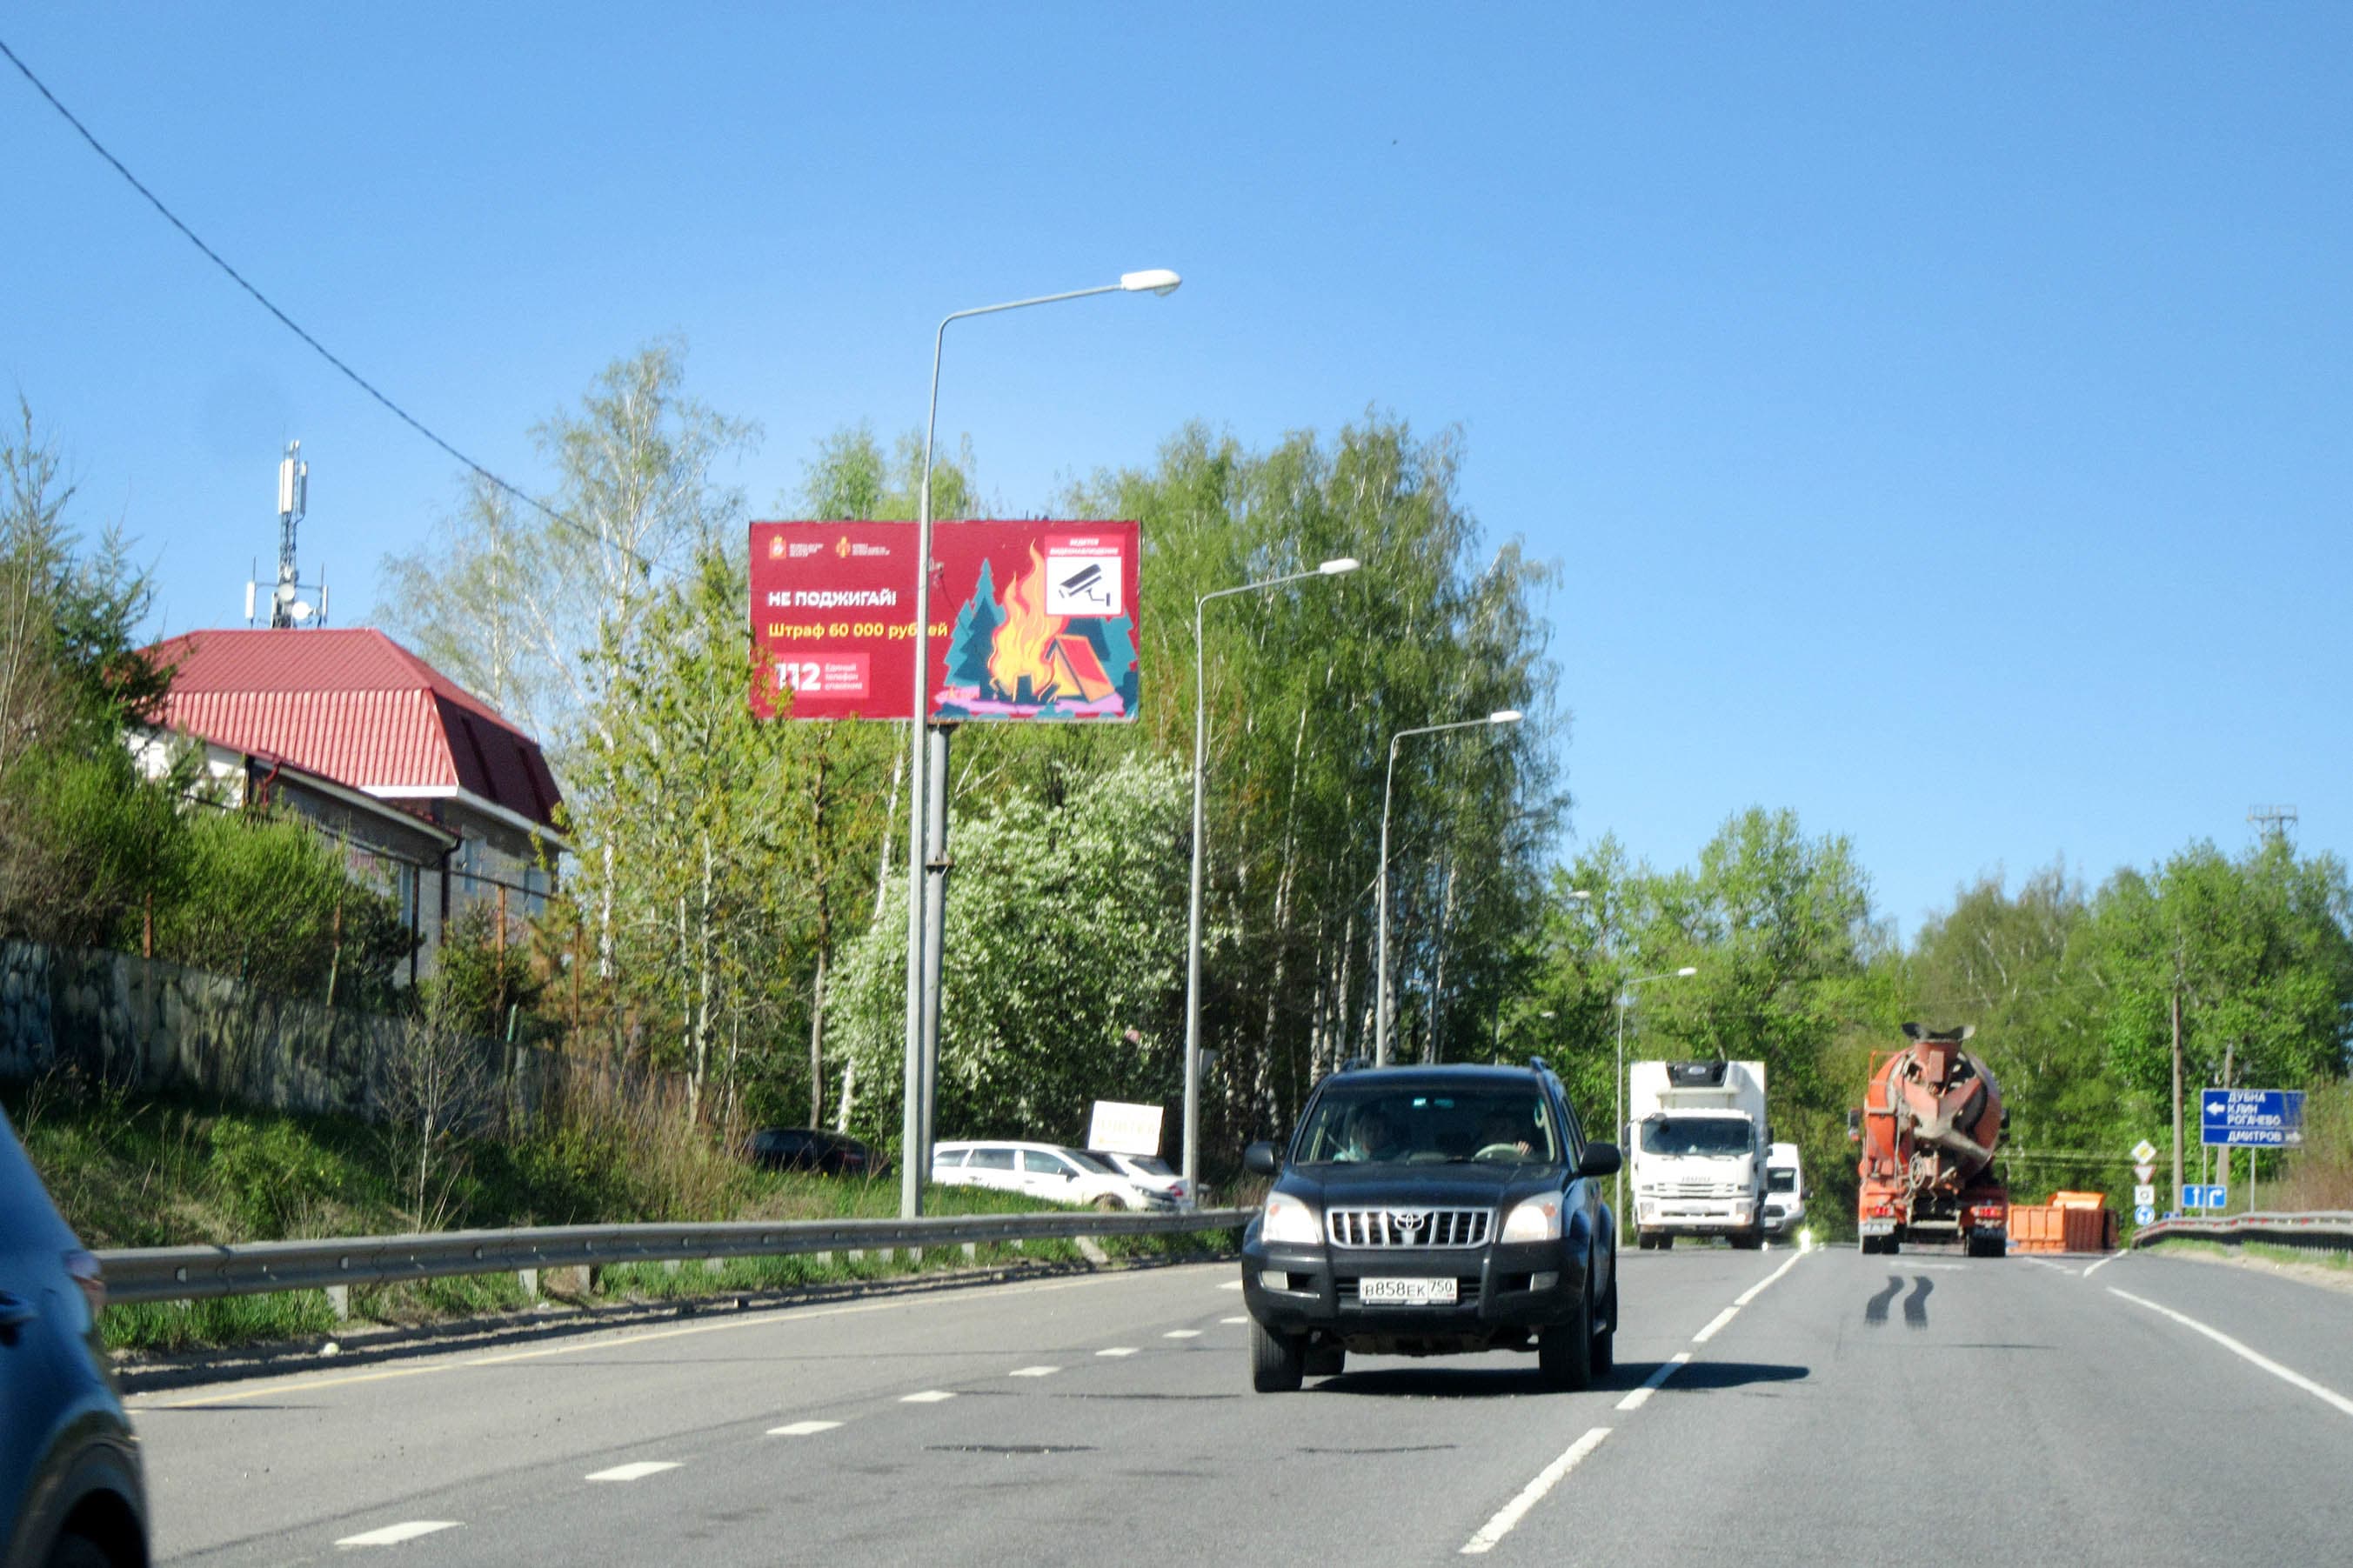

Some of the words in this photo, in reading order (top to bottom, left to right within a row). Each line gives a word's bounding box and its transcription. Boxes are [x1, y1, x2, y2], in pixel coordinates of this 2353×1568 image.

[768, 591, 791, 606] НЕ
[795, 588, 897, 608] ПОДЖИГАЙ!
[769, 623, 825, 639] Штраф
[829, 623, 849, 637] 60
[853, 623, 884, 637] 000
[888, 622, 948, 639] рубей
[775, 663, 821, 691] 112
[2228, 1092, 2265, 1103] ДУБНА
[2228, 1104, 2257, 1114] КЛИН
[2228, 1114, 2281, 1126] РОГАЧЕВО
[2228, 1131, 2283, 1142] ДМИТРОВ
